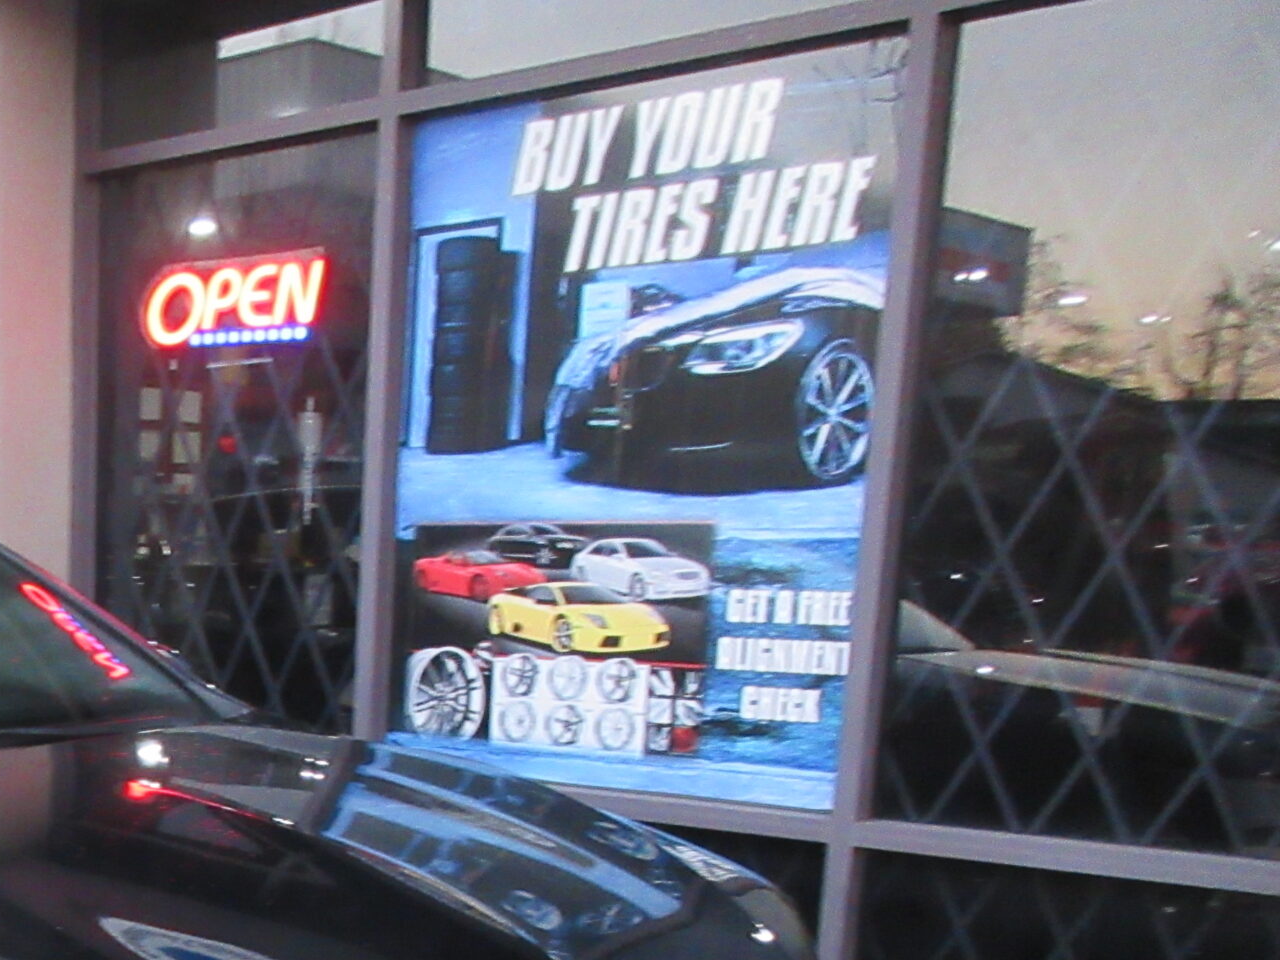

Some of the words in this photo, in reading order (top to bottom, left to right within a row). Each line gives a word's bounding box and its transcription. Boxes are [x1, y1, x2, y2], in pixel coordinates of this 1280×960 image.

[512, 105, 624, 196] BUY
[629, 77, 785, 179] YOUR
[563, 178, 720, 273] TIRES
[720, 155, 877, 255] HERE
[145, 258, 327, 347] OPEN
